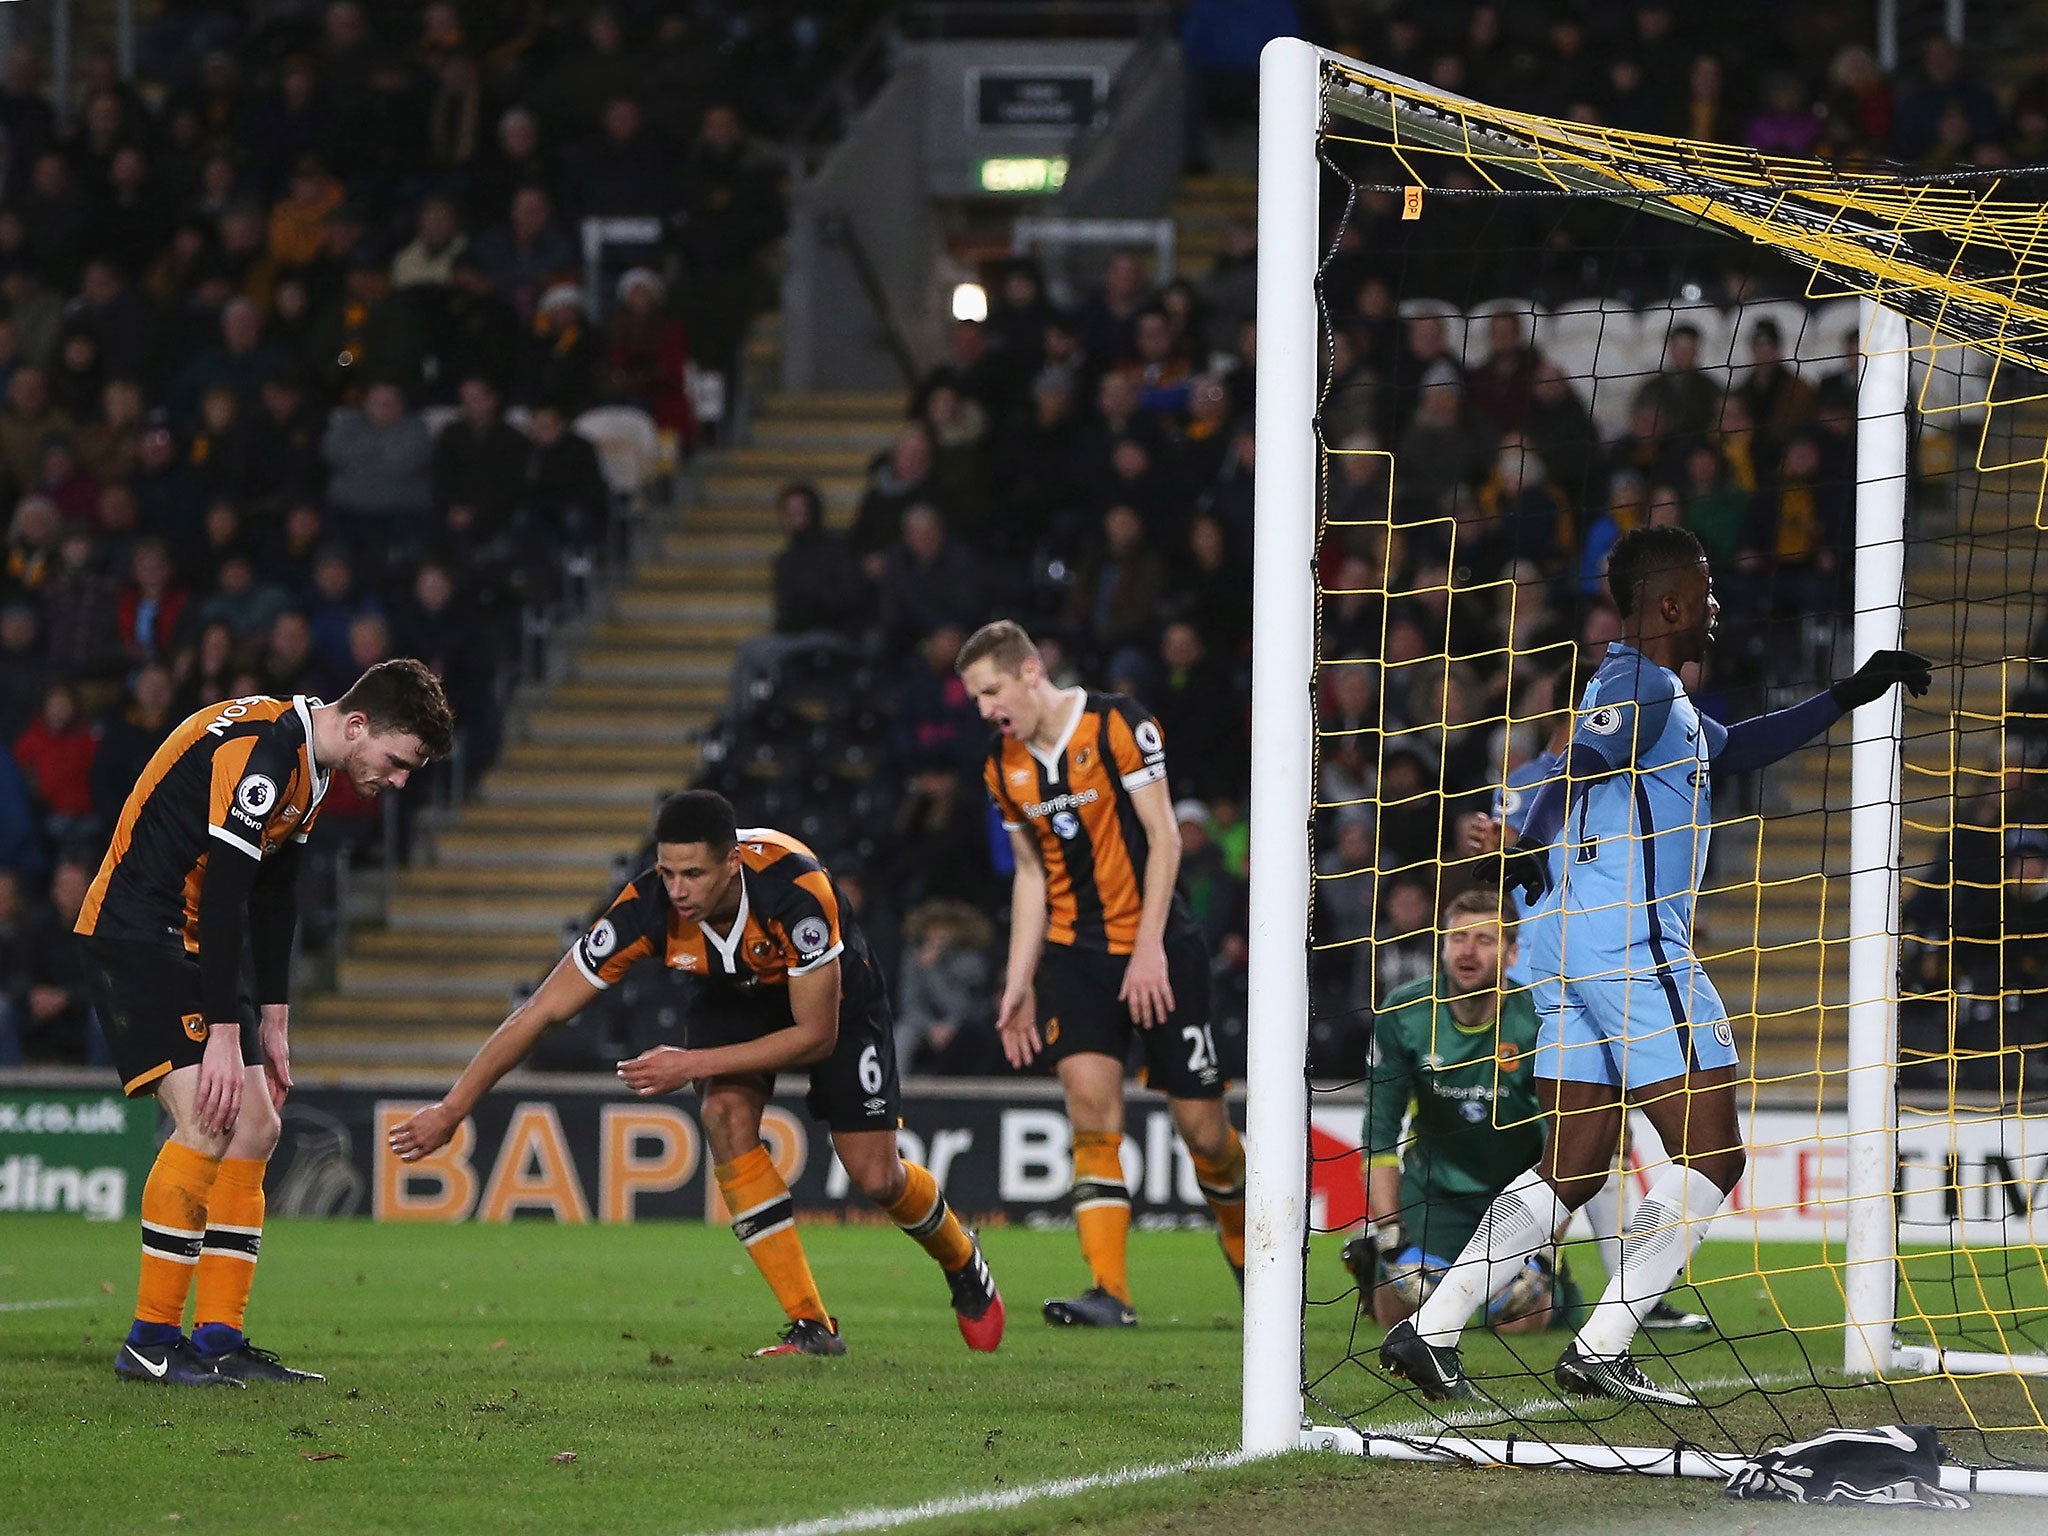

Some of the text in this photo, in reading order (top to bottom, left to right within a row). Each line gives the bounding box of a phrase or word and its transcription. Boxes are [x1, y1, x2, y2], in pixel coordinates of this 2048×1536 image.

[1408, 192, 1419, 213] TOP
[231, 806, 262, 830] umbro
[858, 1045, 882, 1095] 6
[373, 1101, 808, 1223] BAPP
